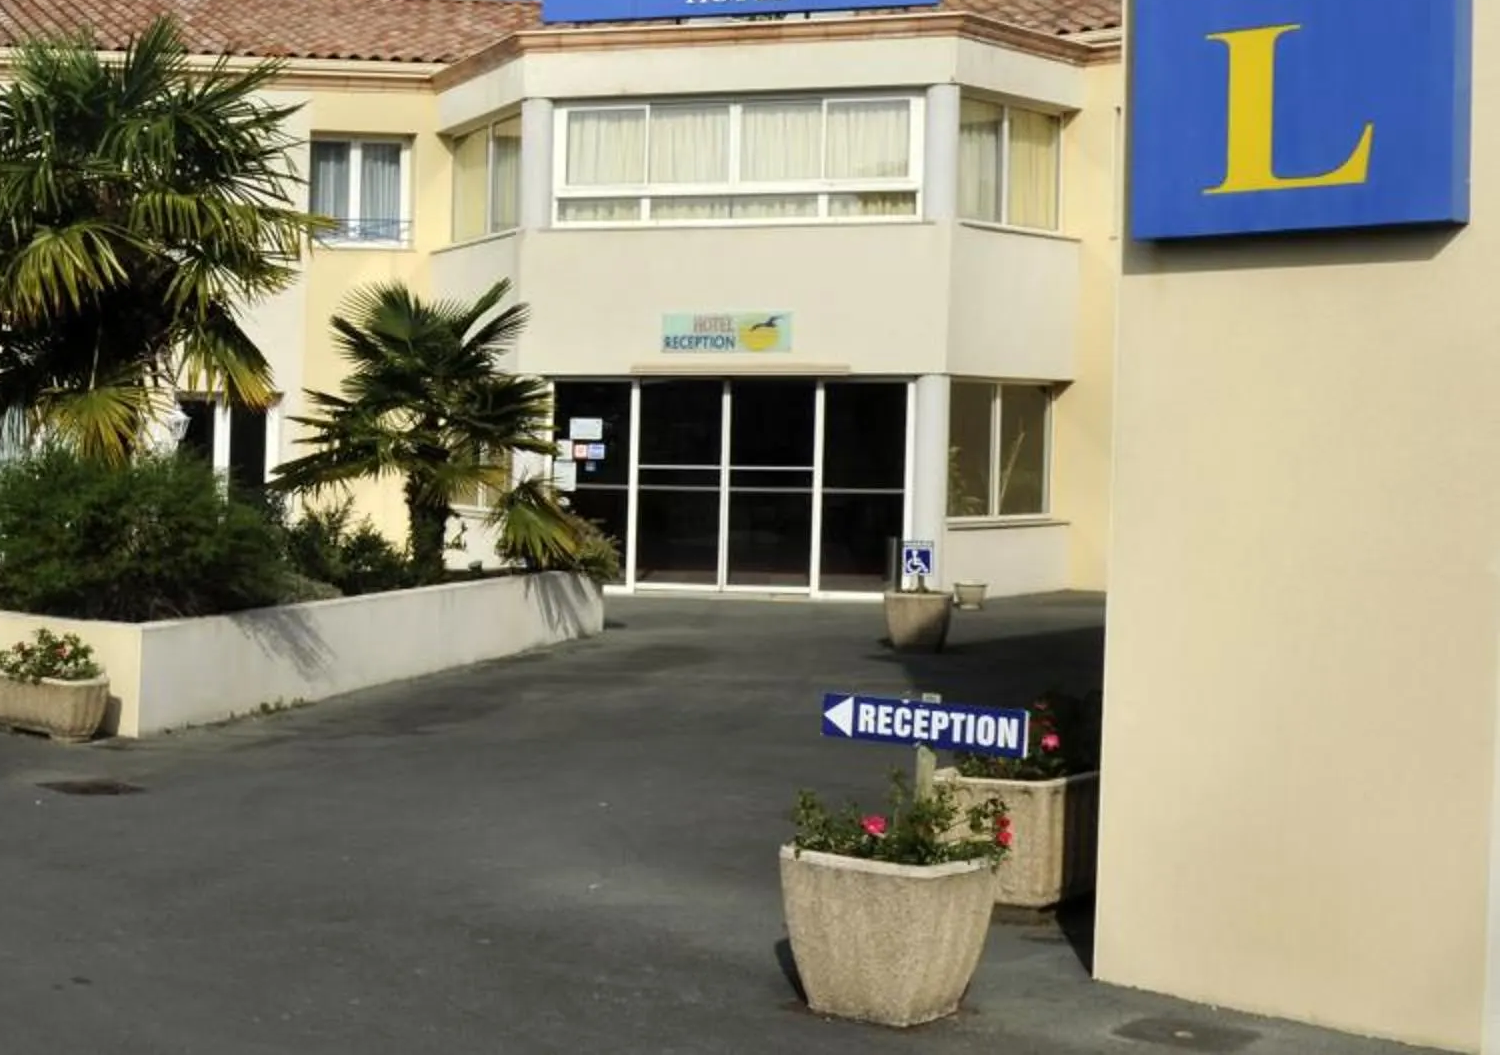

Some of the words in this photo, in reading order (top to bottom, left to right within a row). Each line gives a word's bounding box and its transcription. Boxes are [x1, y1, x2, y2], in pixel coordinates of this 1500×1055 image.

[693, 315, 735, 333] HOTEL
[663, 334, 737, 350] RECEPTION
[857, 702, 1019, 750] RECEPTION
